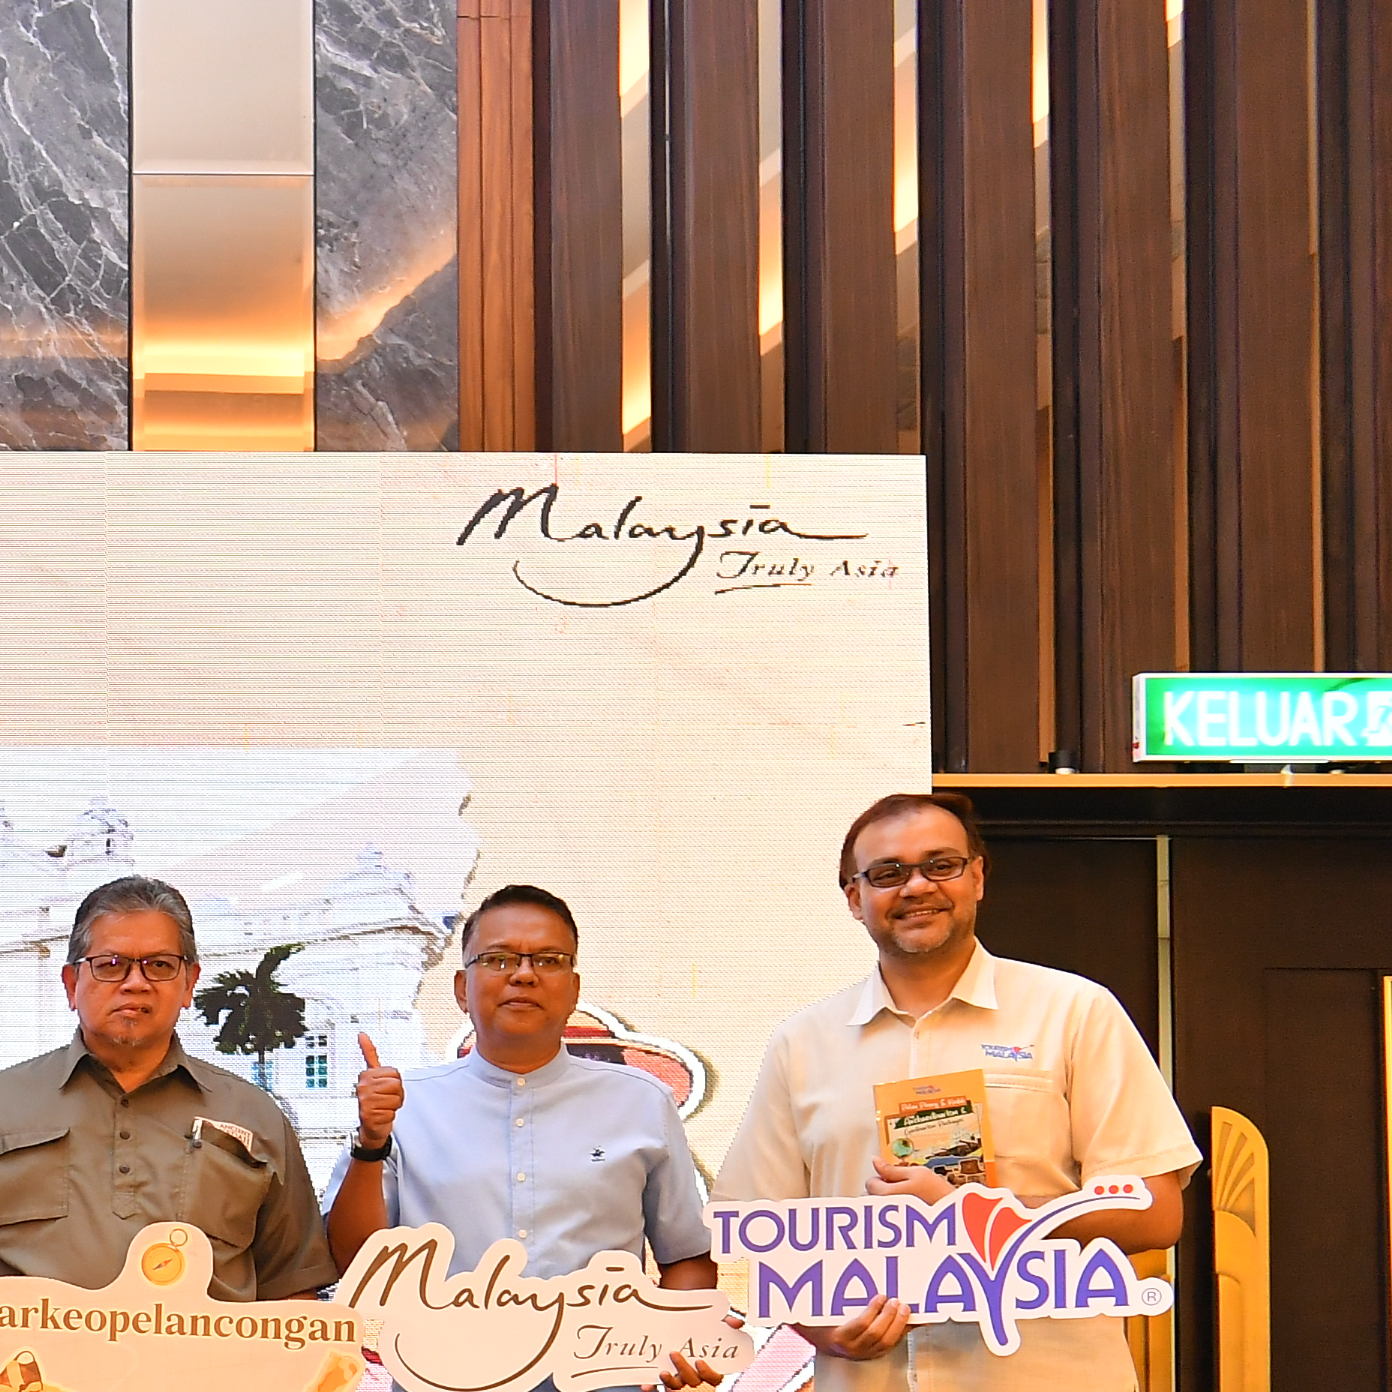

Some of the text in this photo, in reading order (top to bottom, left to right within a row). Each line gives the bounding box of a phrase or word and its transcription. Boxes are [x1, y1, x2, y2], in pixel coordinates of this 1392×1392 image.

[456, 483, 869, 607] Malaysia
[716, 551, 900, 582] Truly Asia
[1164, 691, 1359, 746] KELUAR
[713, 1202, 957, 1254] TOURISM
[348, 1238, 714, 1392] Malaysia
[758, 1248, 1130, 1347] MALAYSIA
[573, 1324, 739, 1364] Truly Asia
